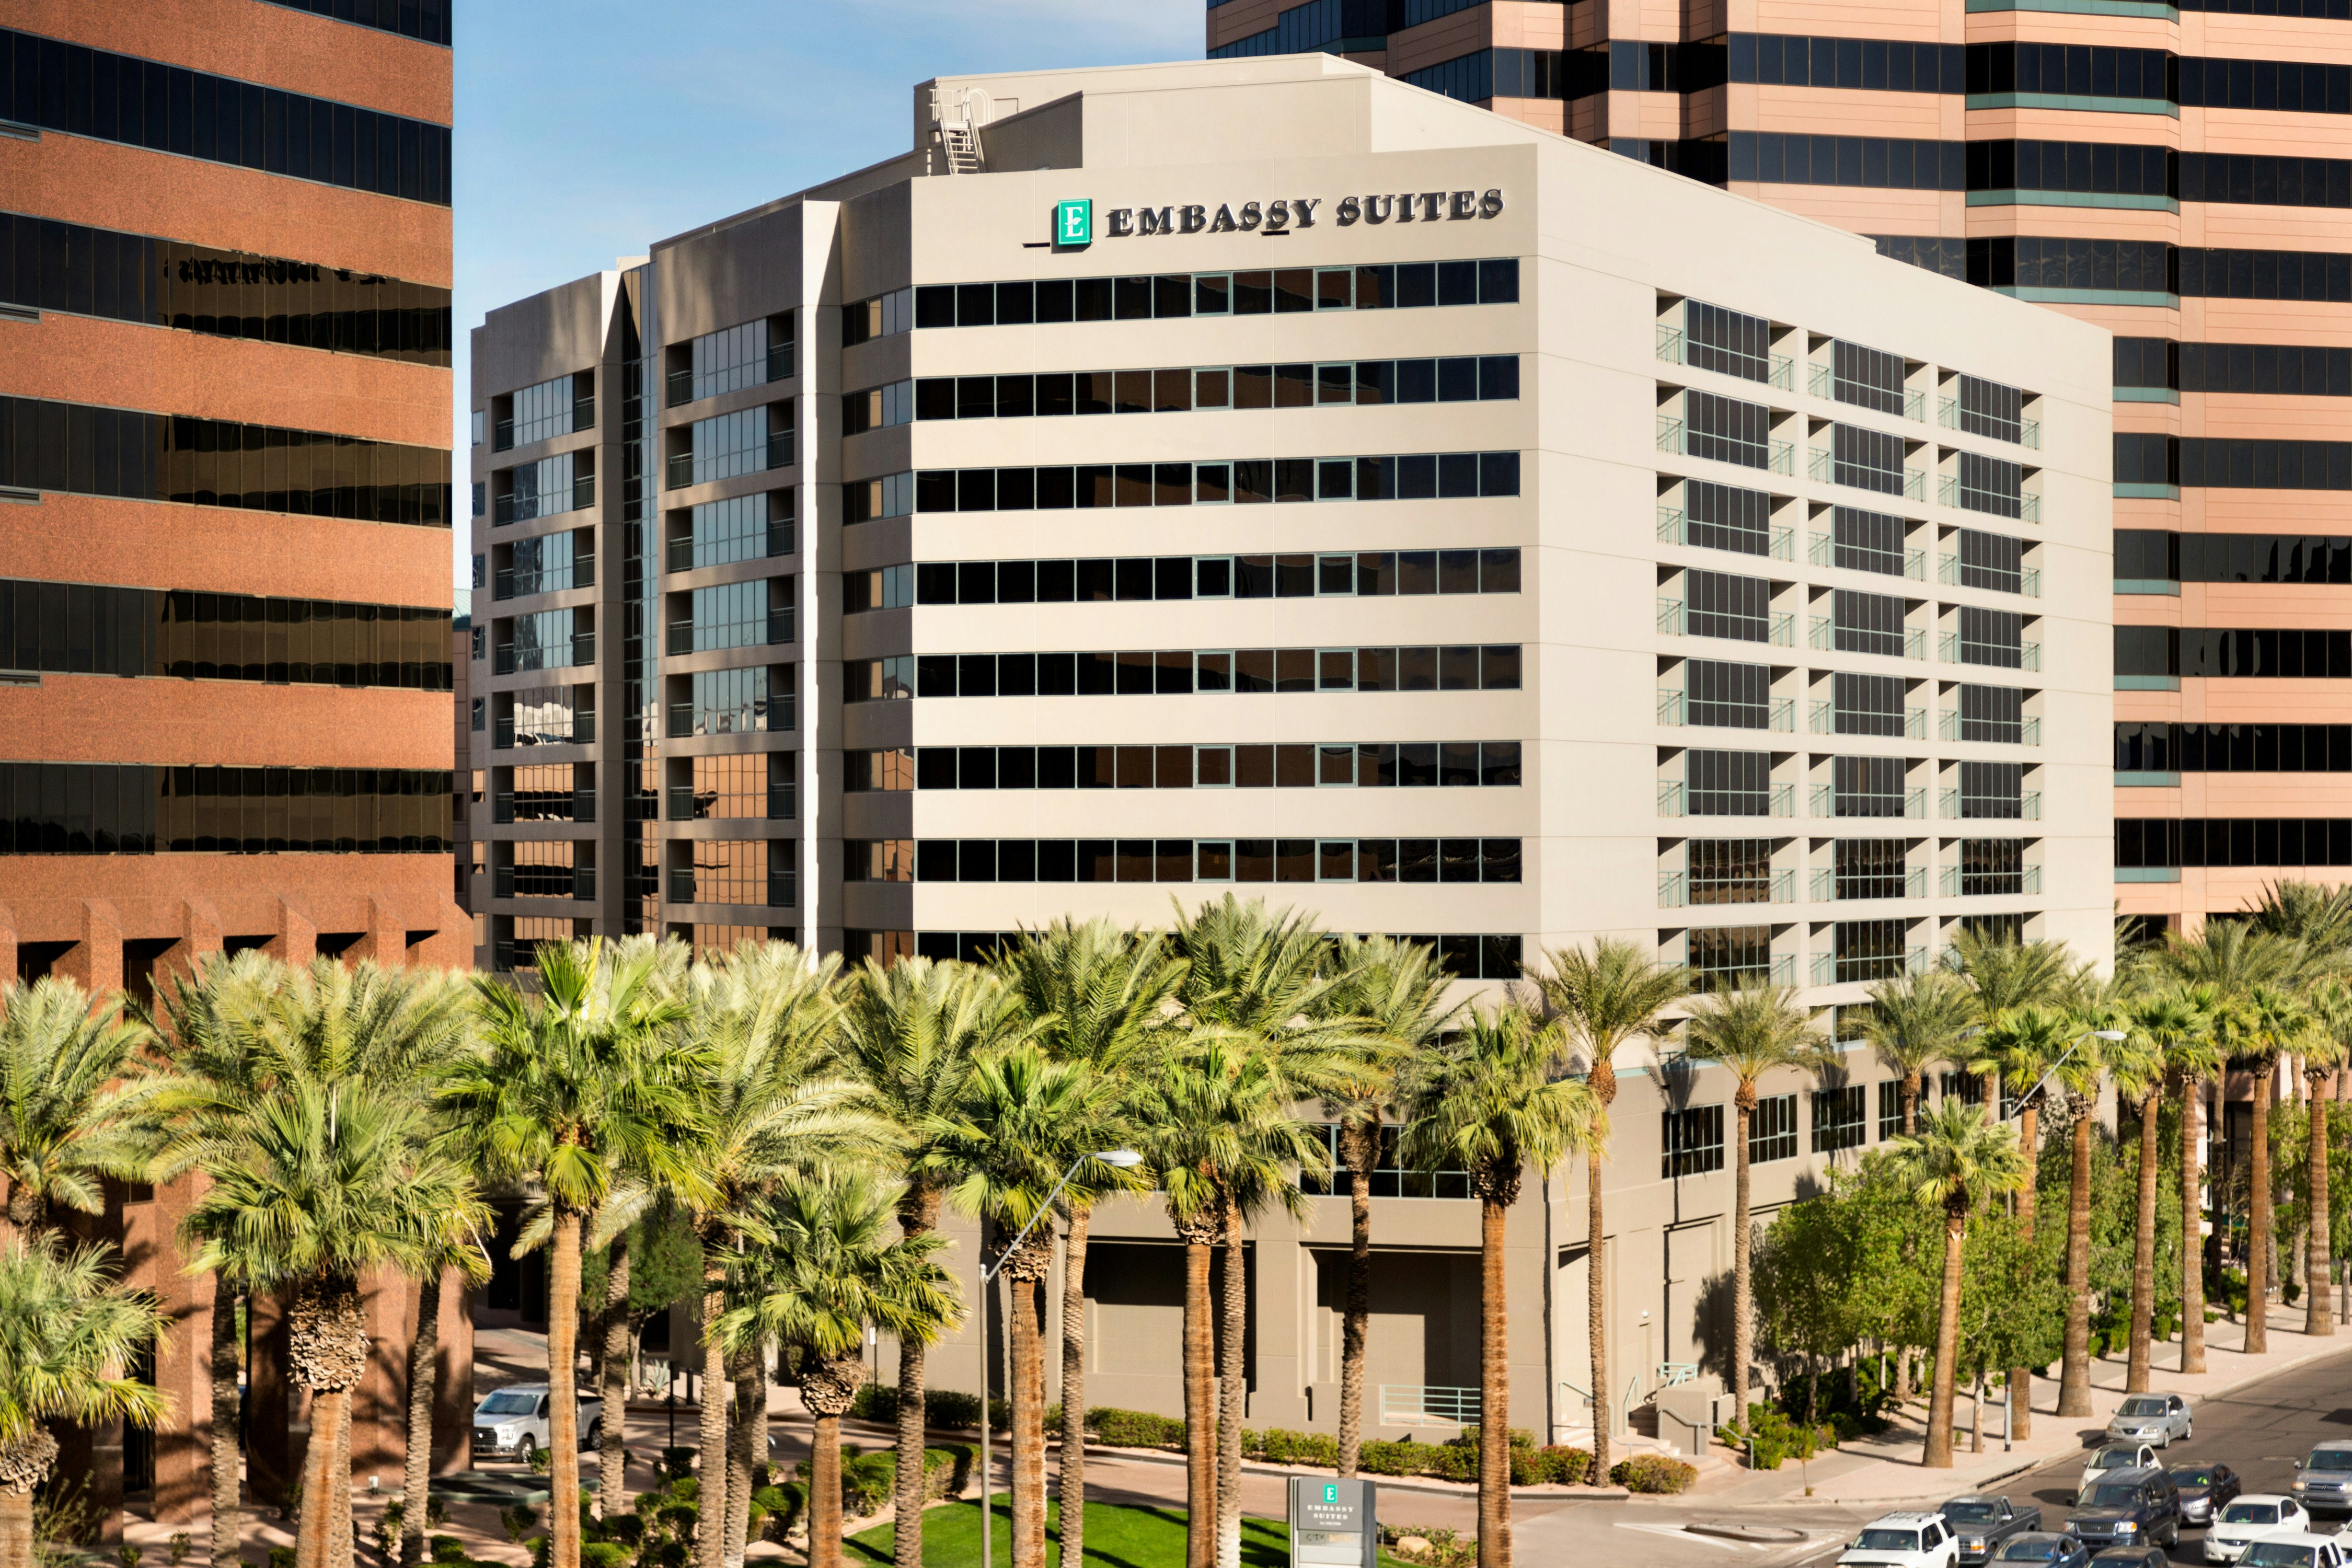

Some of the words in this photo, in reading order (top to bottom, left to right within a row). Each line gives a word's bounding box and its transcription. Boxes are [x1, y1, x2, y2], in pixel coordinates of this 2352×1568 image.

[1064, 206, 1083, 237] E
[1108, 198, 1323, 235] EMBASSY
[1340, 188, 1505, 223] SUITES
[1327, 1487, 1335, 1501] E
[1307, 1504, 1354, 1513] EMBASSY
